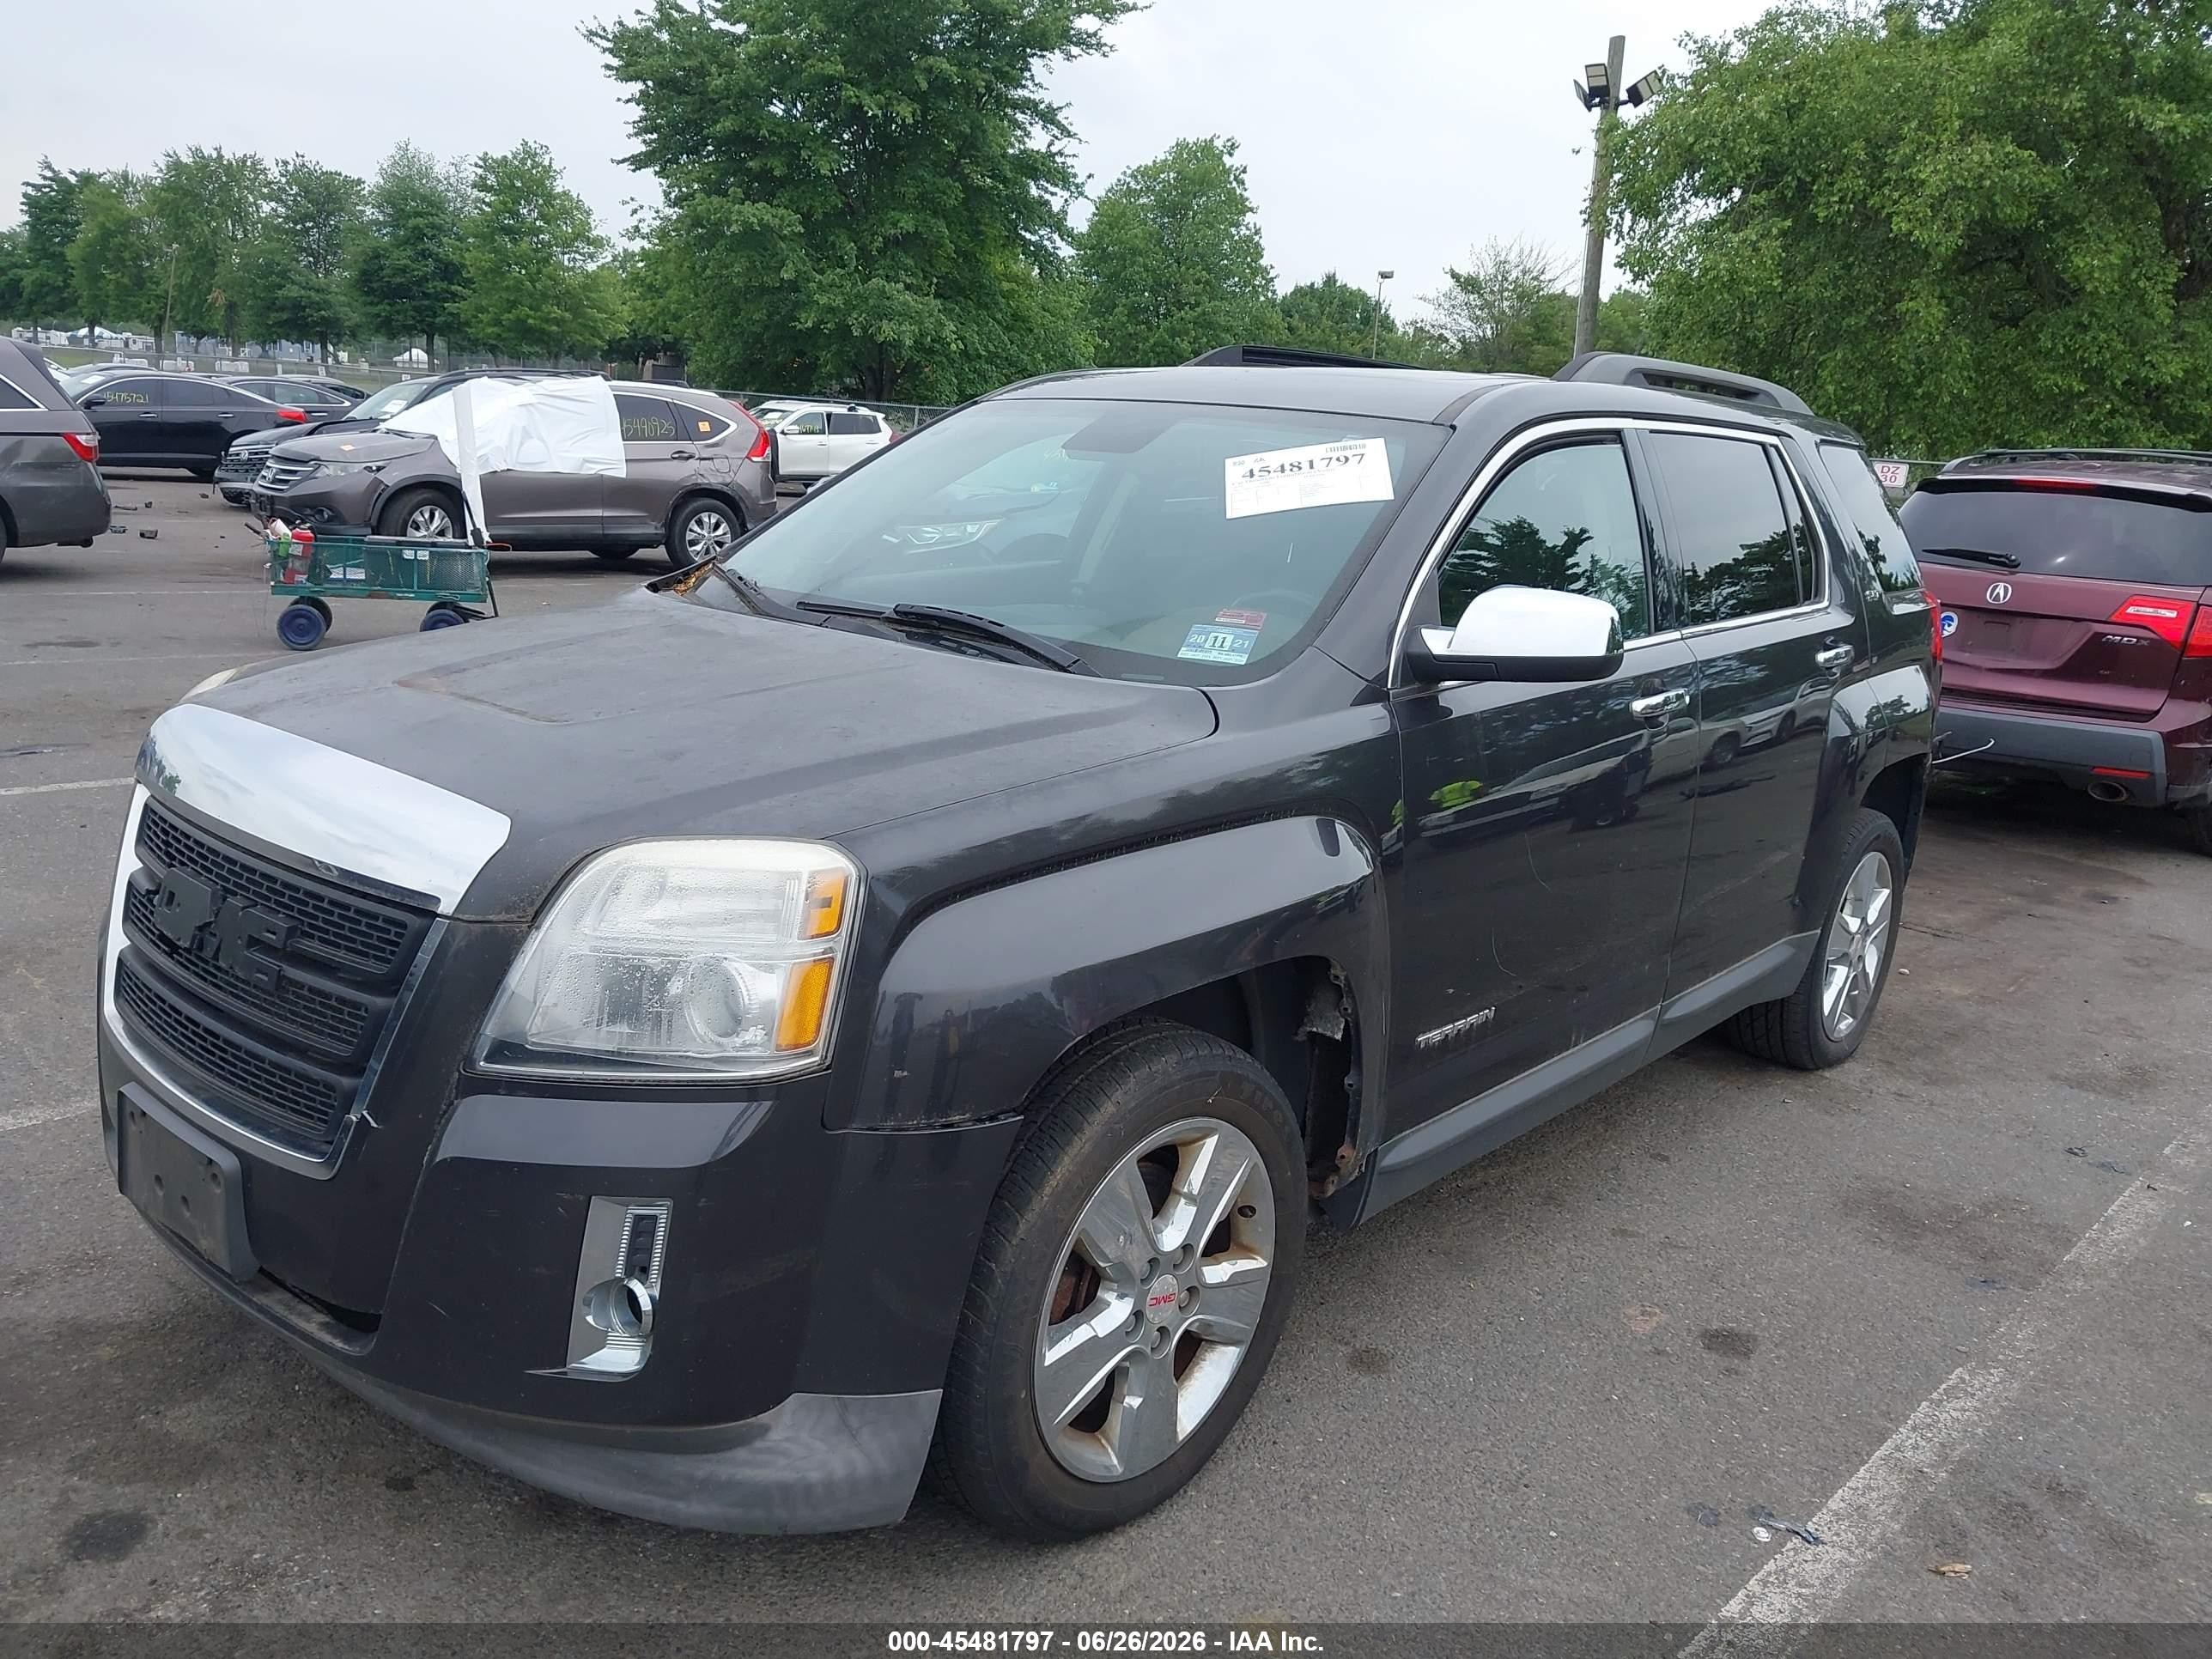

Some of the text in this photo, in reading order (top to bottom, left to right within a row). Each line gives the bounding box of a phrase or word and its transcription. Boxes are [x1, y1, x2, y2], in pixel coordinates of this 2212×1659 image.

[1242, 453, 1365, 479] 45481797
[1881, 465, 1900, 474] DZ
[1189, 635, 1249, 648] 20 11 21
[2102, 635, 2150, 646] MDX
[1415, 1006, 1496, 1049] TERRAIN
[1148, 1292, 1176, 1307] GMC
